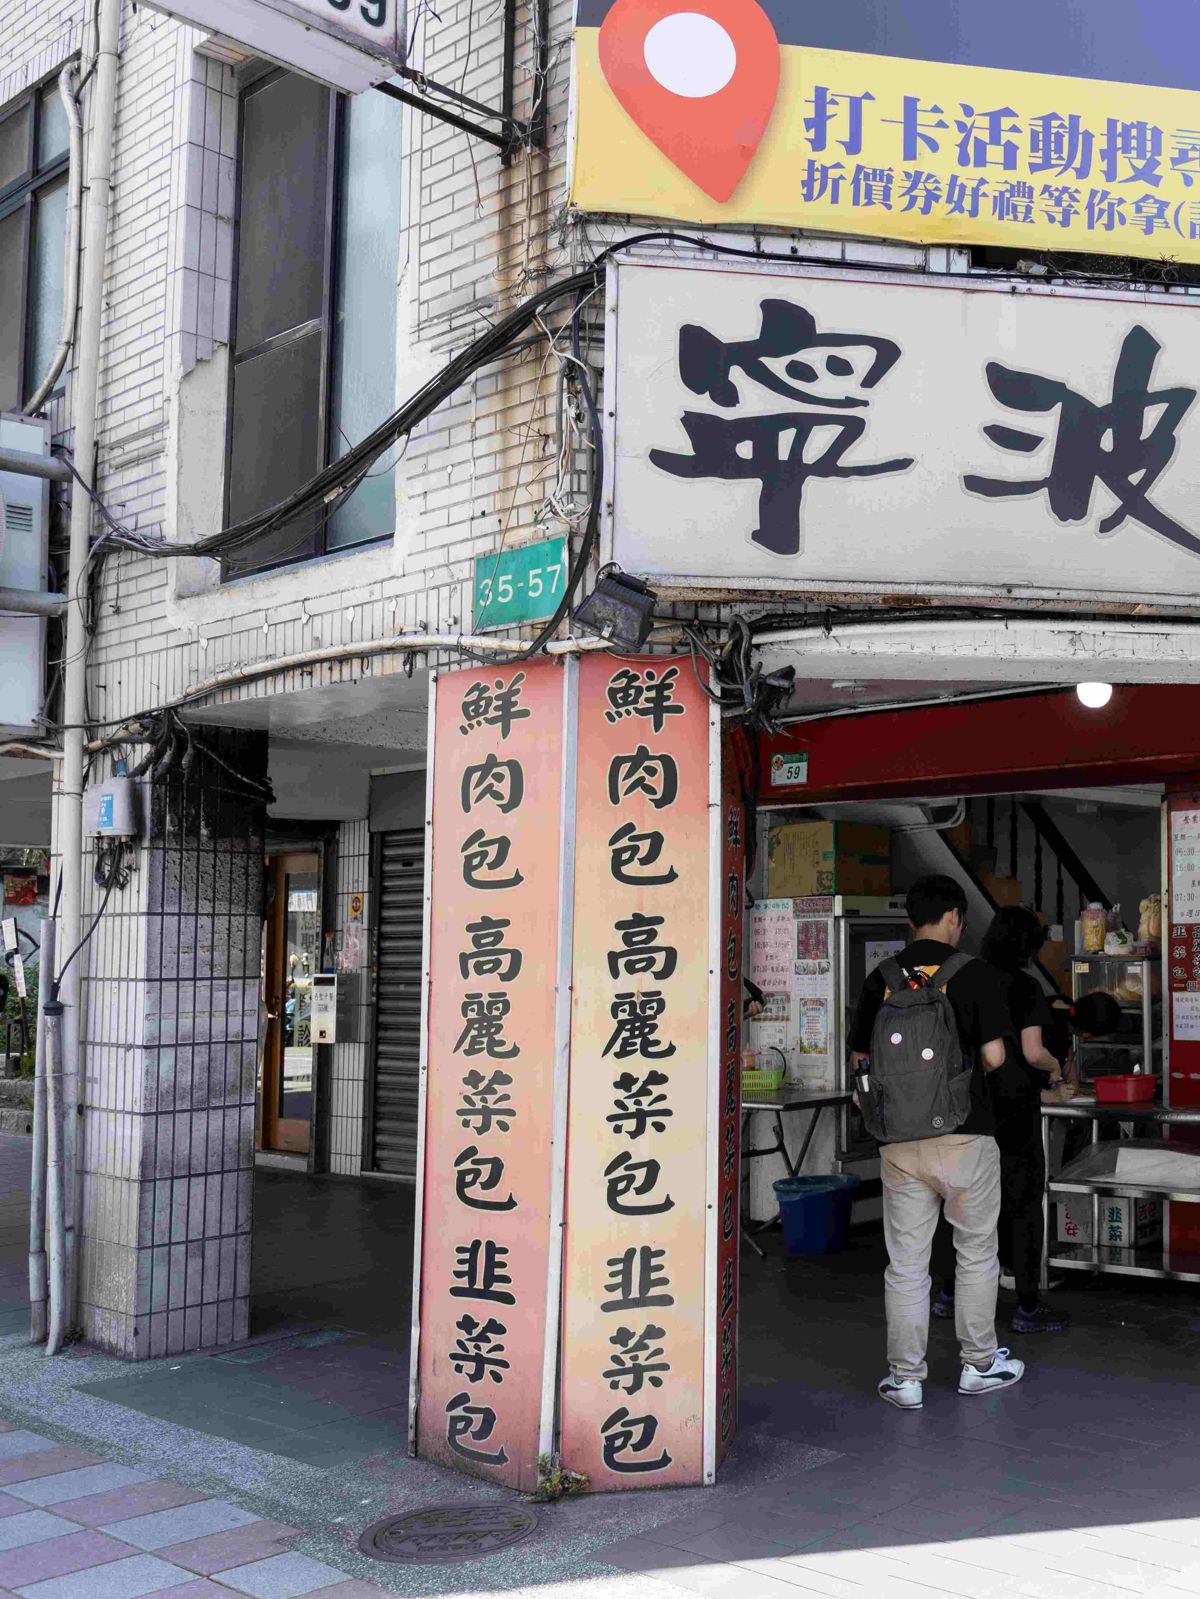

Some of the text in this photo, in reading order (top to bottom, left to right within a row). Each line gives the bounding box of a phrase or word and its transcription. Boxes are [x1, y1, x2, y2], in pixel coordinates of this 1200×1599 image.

[478, 564, 562, 607] 35-57
[458, 671, 531, 890] 鮮肉包
[786, 766, 801, 780] 59
[452, 915, 523, 1211] 高麗菜包
[599, 667, 686, 1474] 鮮肉包 高麗菜包 韭菜包
[445, 1238, 517, 1466] 韭菜包
